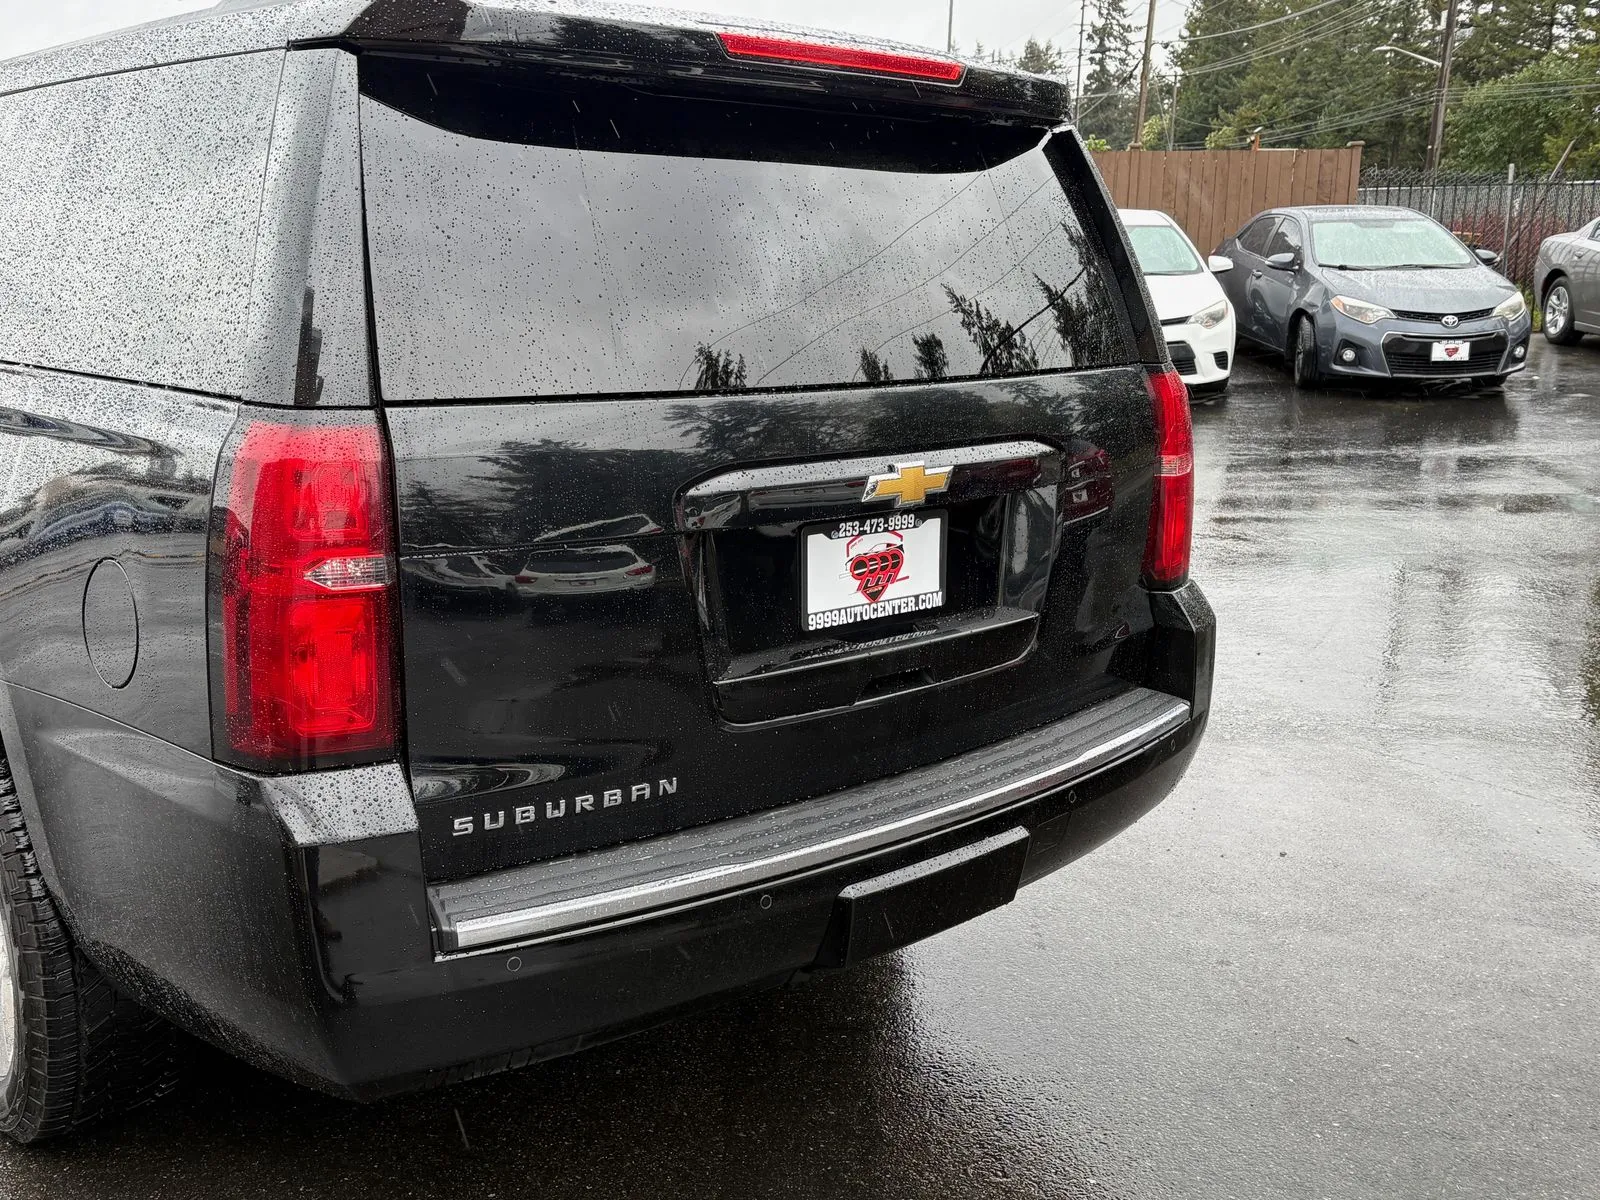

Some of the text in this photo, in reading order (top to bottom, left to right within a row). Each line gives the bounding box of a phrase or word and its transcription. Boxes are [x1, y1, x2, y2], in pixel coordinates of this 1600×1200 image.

[838, 513, 915, 538] 253-473-9999
[808, 591, 943, 631] 9999AUTOCENTER.COM
[452, 777, 678, 836] SUBURBAN
